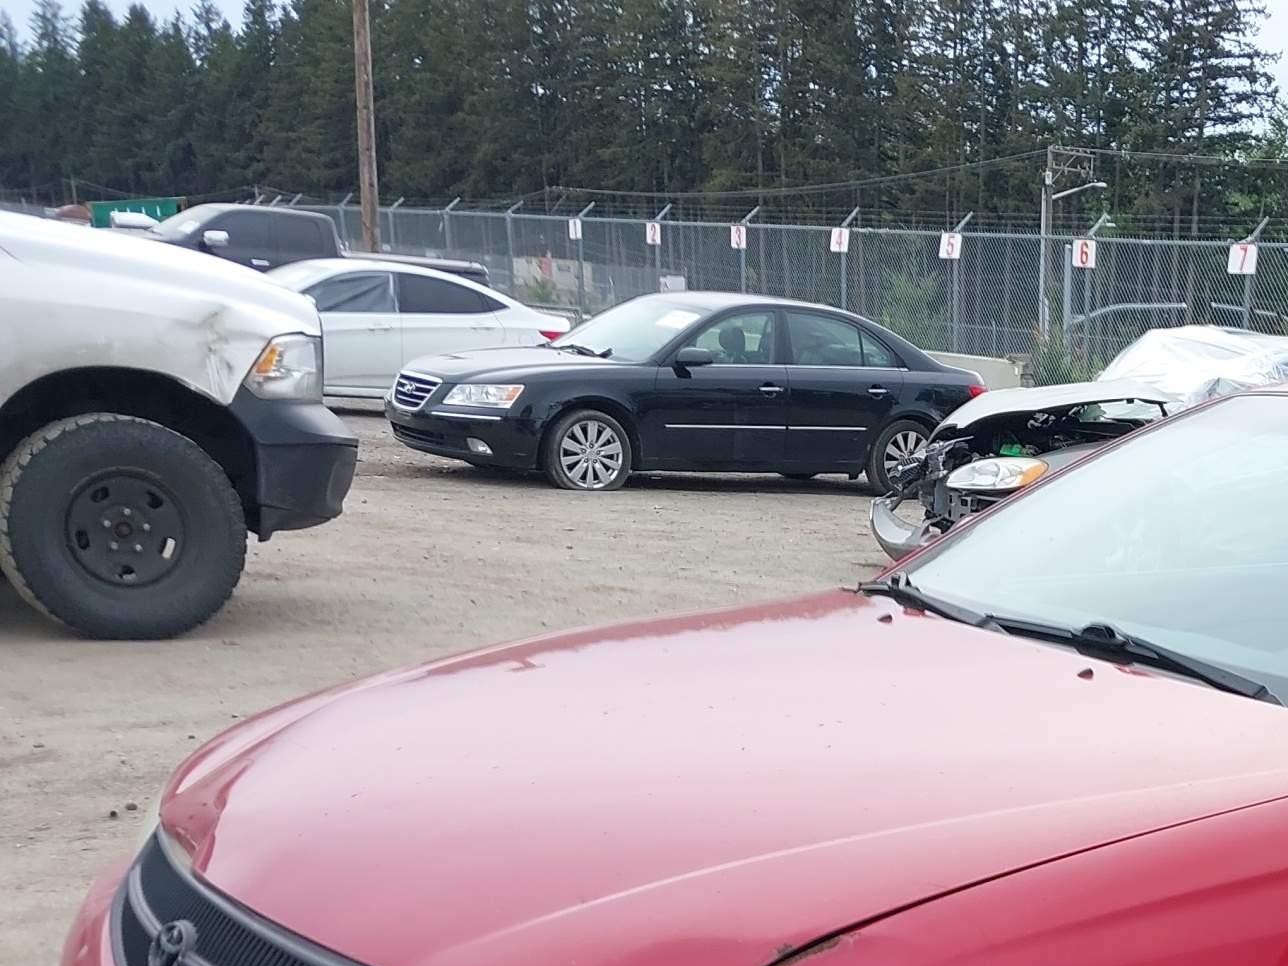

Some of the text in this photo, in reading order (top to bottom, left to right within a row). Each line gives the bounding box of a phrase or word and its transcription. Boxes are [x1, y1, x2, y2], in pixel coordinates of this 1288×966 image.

[649, 223, 658, 243] 2
[734, 227, 743, 247] 3
[834, 229, 844, 249] 4
[945, 234, 955, 257] 5
[1079, 242, 1089, 265] 6
[1239, 245, 1249, 273] 7
